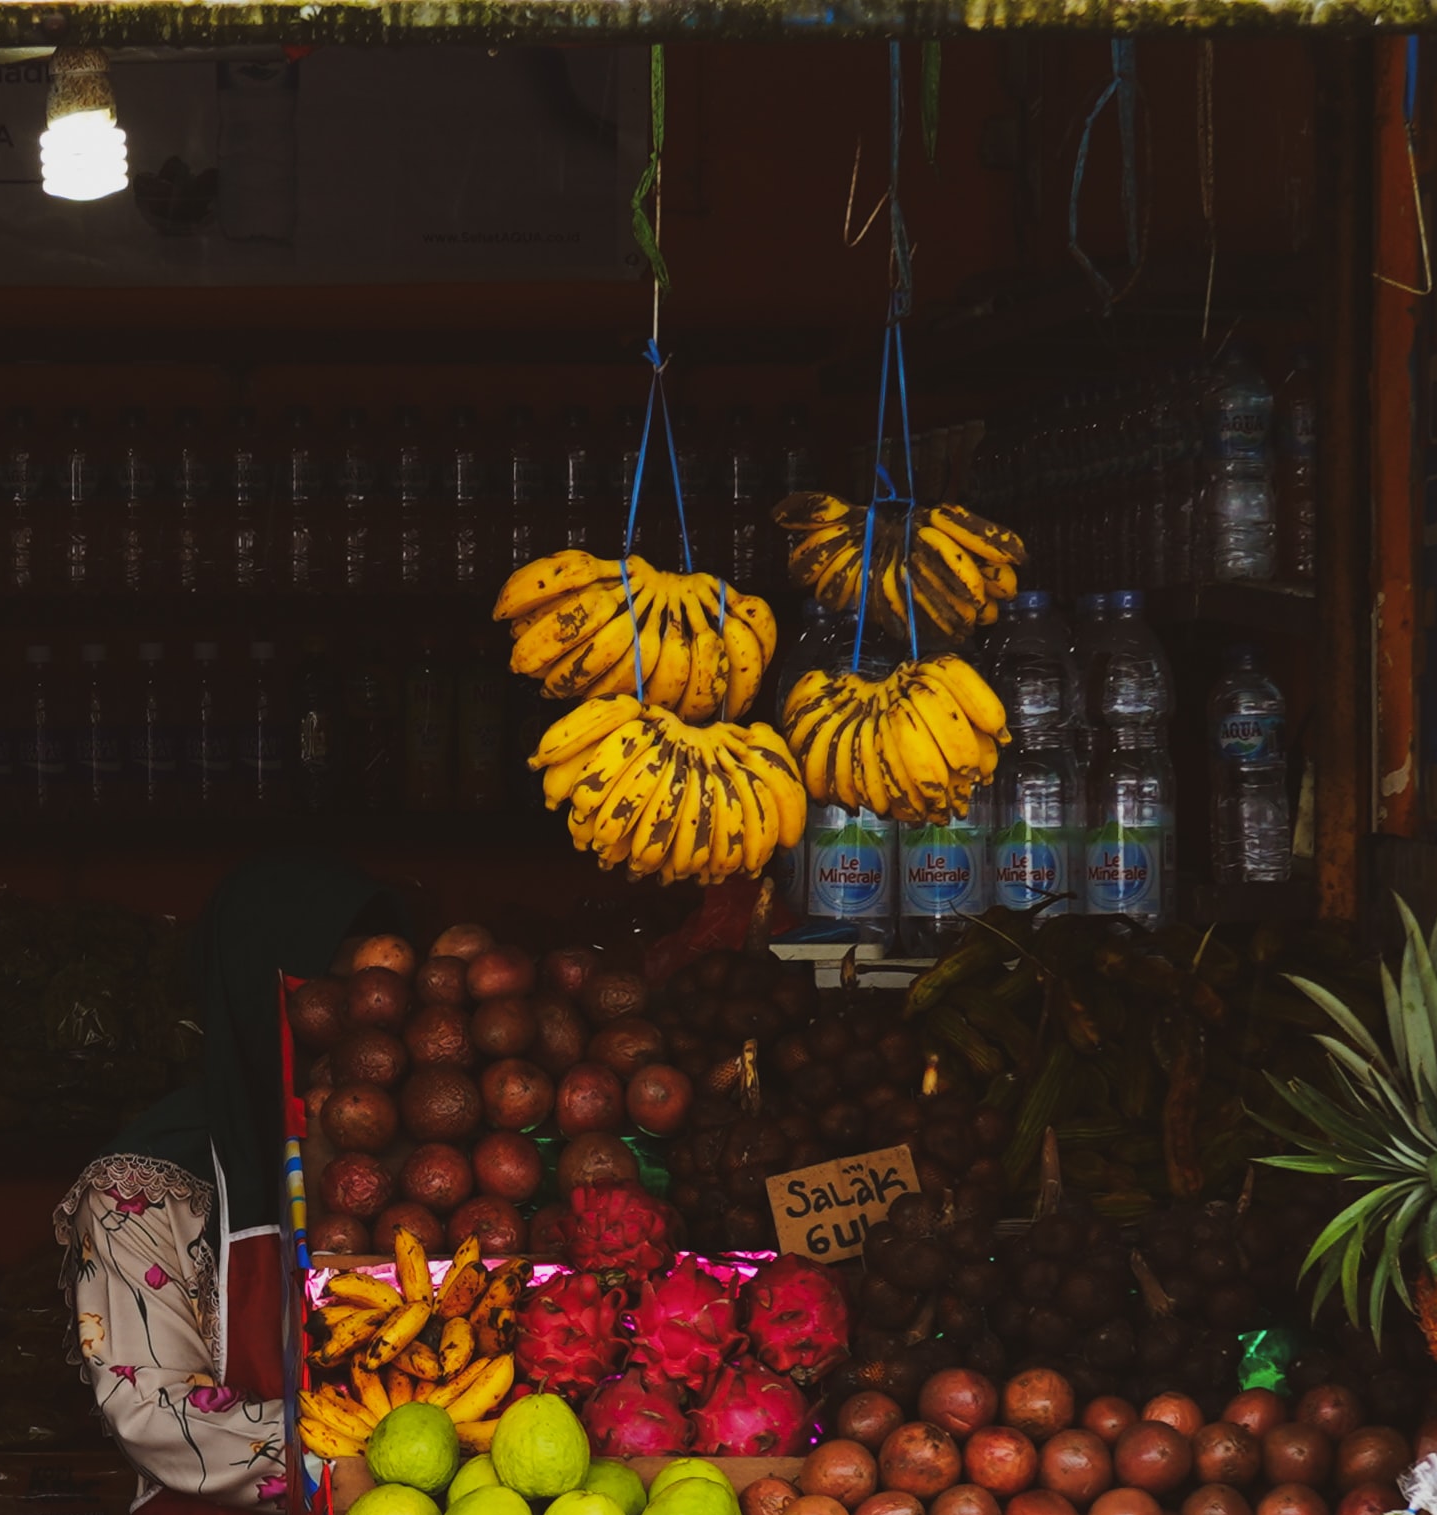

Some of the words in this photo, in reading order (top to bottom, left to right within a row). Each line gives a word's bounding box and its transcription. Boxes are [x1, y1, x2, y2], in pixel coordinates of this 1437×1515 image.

[1221, 415, 1265, 432] AQUA
[1222, 722, 1262, 740] AQUA
[840, 855, 859, 870] Le
[927, 854, 945, 869] Le
[1012, 853, 1027, 868] Le
[1105, 852, 1119, 867] Le
[819, 868, 881, 884] Minerale
[909, 868, 970, 883] Minerale
